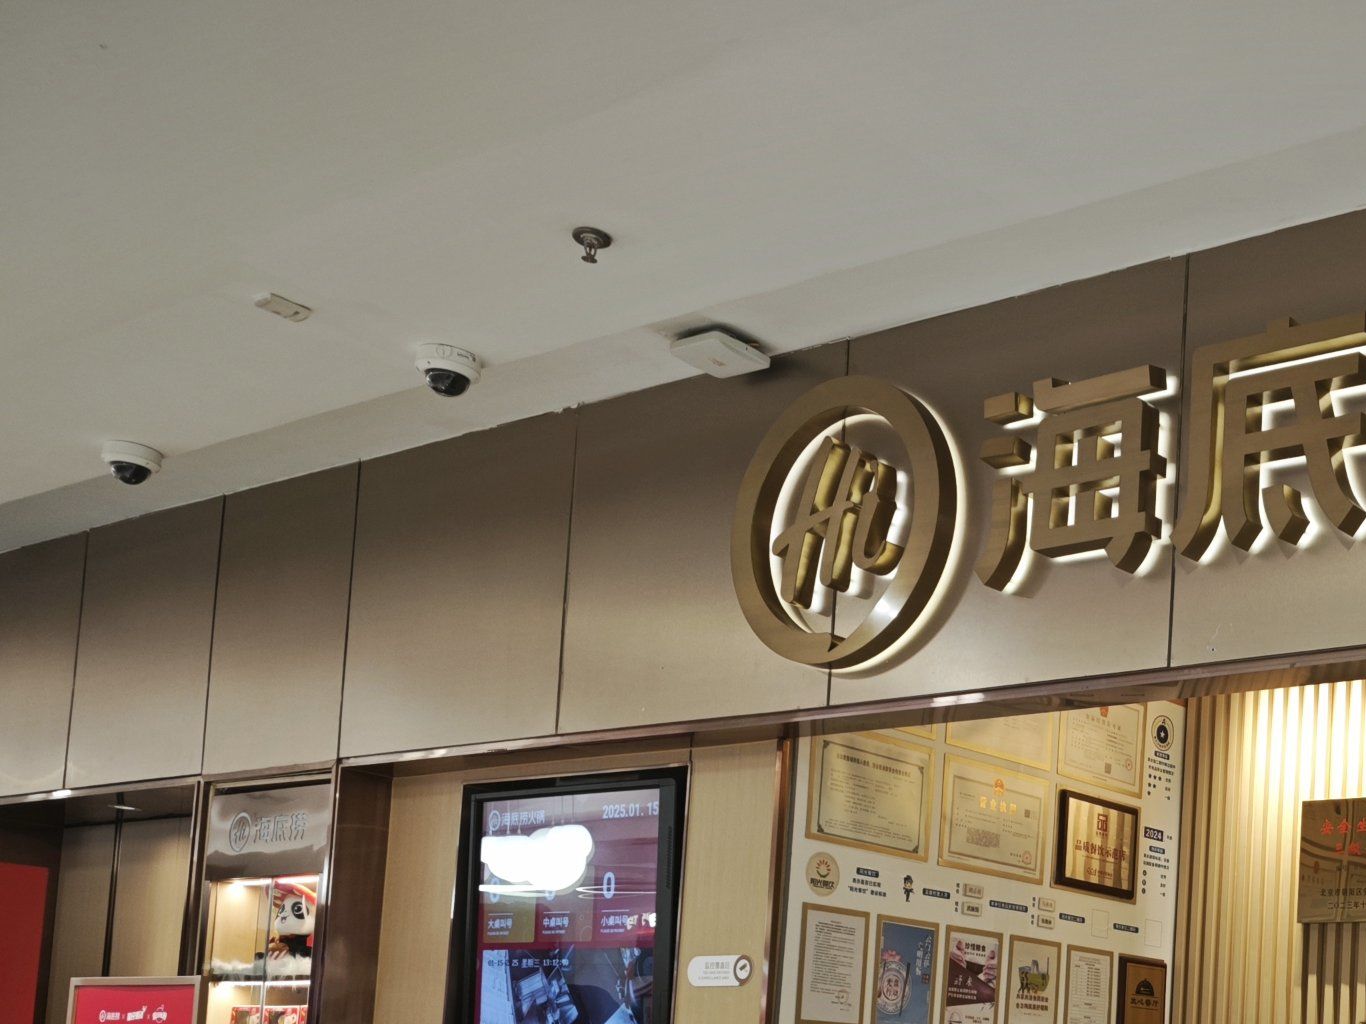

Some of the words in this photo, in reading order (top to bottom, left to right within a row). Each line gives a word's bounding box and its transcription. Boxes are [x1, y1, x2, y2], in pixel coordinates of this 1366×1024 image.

[254, 811, 308, 844] 海底捞
[502, 809, 546, 827] 海底捞火锅
[1145, 828, 1163, 841] 2024
[603, 871, 615, 900] 0
